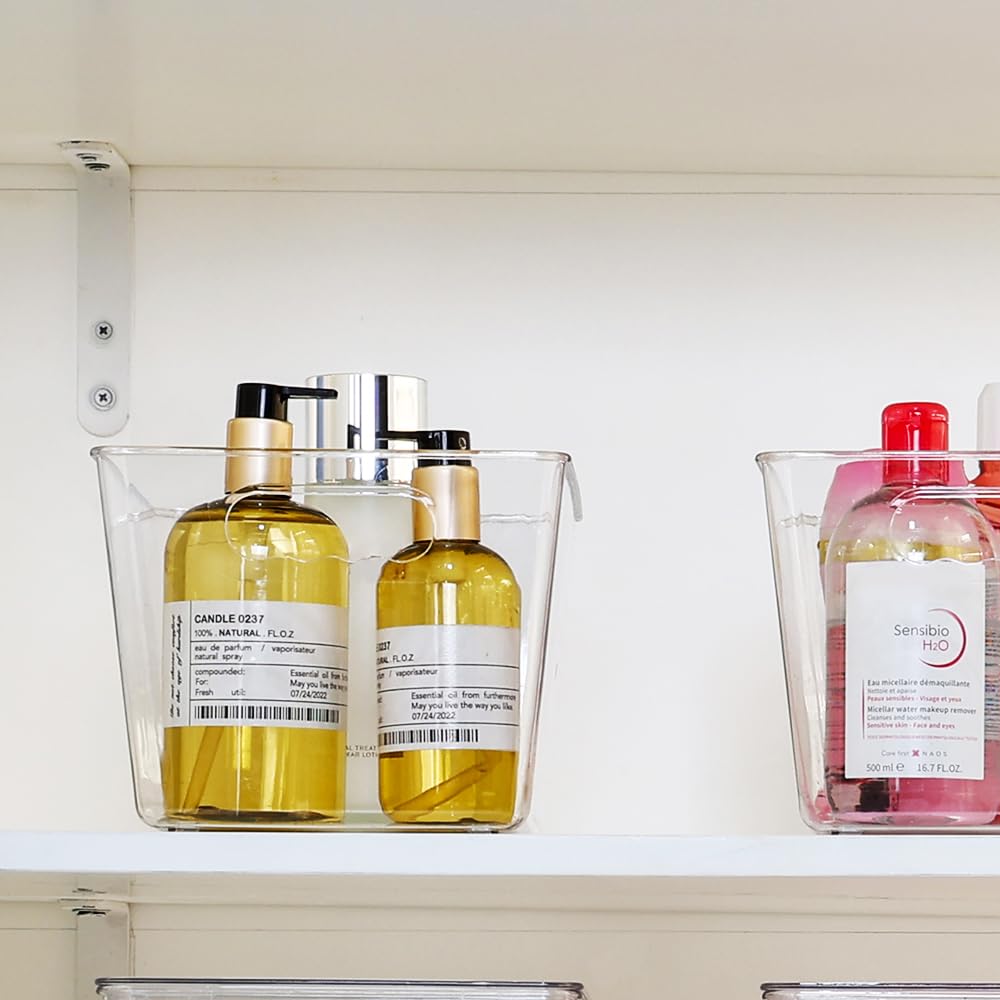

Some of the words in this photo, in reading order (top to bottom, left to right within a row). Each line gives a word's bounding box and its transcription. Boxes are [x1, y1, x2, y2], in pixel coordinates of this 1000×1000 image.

[194, 614, 235, 624] CANDLE
[238, 614, 264, 624] 0237
[218, 629, 261, 638] NATURAL
[894, 624, 949, 637] Sensibio
[210, 644, 220, 652] de
[224, 644, 252, 654] parfum
[271, 646, 316, 654] vaporisateur
[922, 640, 949, 651] H2O
[194, 653, 218, 661] natural
[290, 669, 319, 678] Essential
[395, 669, 438, 677] vaporisateur
[290, 680, 305, 689] May
[306, 682, 319, 690] you
[881, 679, 918, 687] micellaire
[411, 691, 443, 700] Essential
[448, 691, 458, 699] oil
[462, 691, 480, 699] from
[411, 702, 426, 711] May
[428, 703, 443, 711] you
[444, 702, 459, 710] live
[460, 701, 473, 709] the
[475, 703, 489, 711] way
[490, 703, 501, 711] you
[919, 706, 949, 714] makeup
[411, 712, 456, 720] 07/24/2022
[866, 763, 881, 772] 500
[882, 763, 894, 772] ml
[917, 764, 935, 772] 16.7
